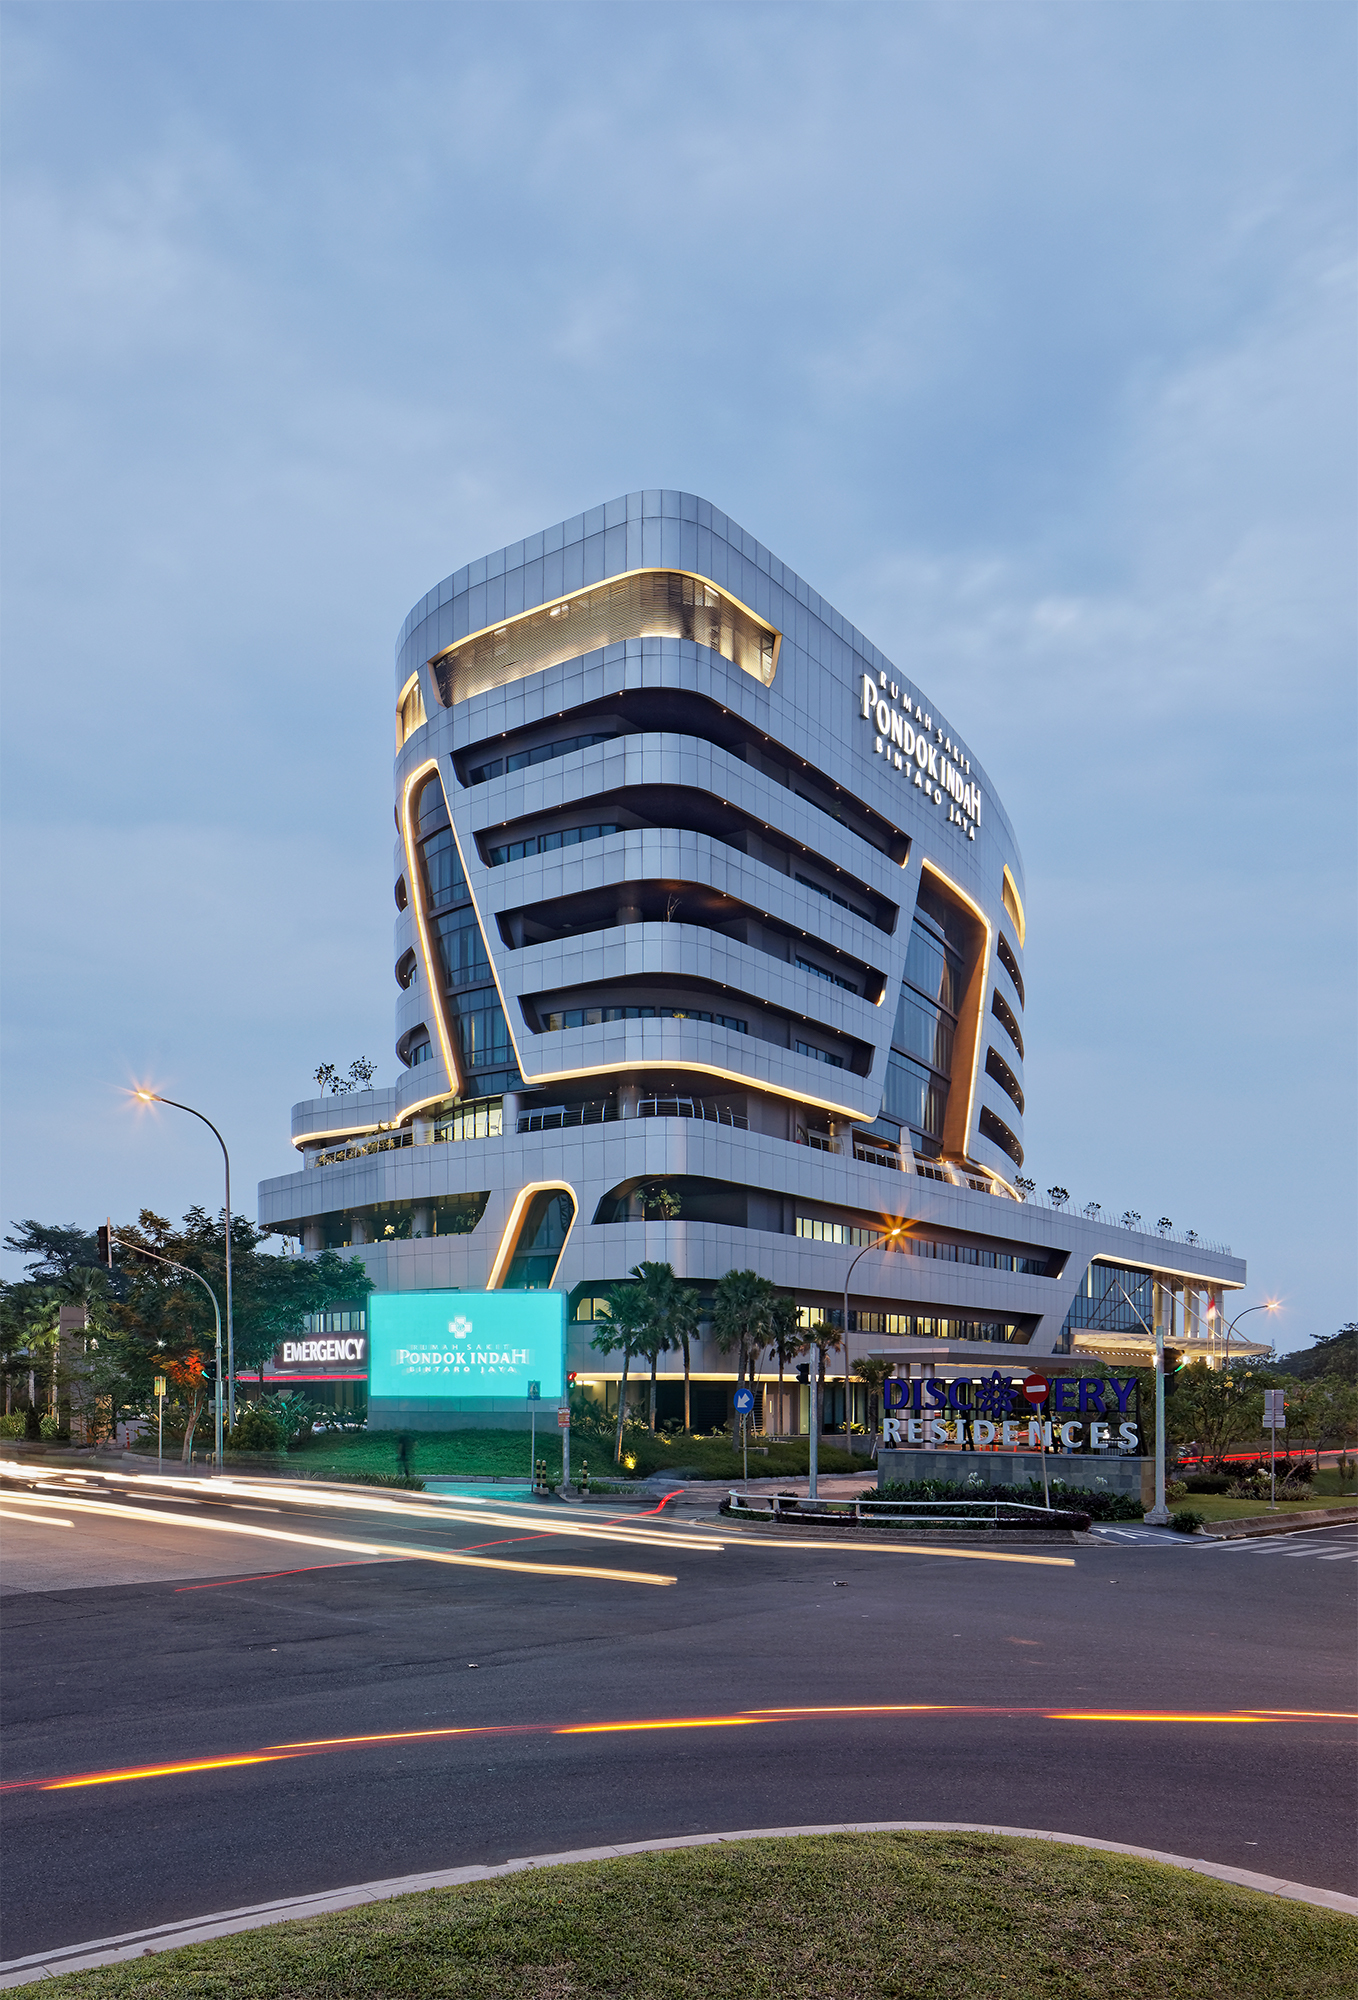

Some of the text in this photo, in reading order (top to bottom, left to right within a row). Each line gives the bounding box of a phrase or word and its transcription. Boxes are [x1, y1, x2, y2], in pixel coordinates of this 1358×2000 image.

[880, 671, 970, 775] RUMAH SAKIT
[861, 673, 982, 827] PONDOK INDAH
[875, 736, 975, 841] BINTARO JAYA
[283, 1338, 365, 1362] EMERGENCY
[398, 1349, 528, 1365] PONDOK INDAH
[408, 1366, 515, 1374] BINTARO JAYA
[882, 1417, 1139, 1450] RESIDENCES
